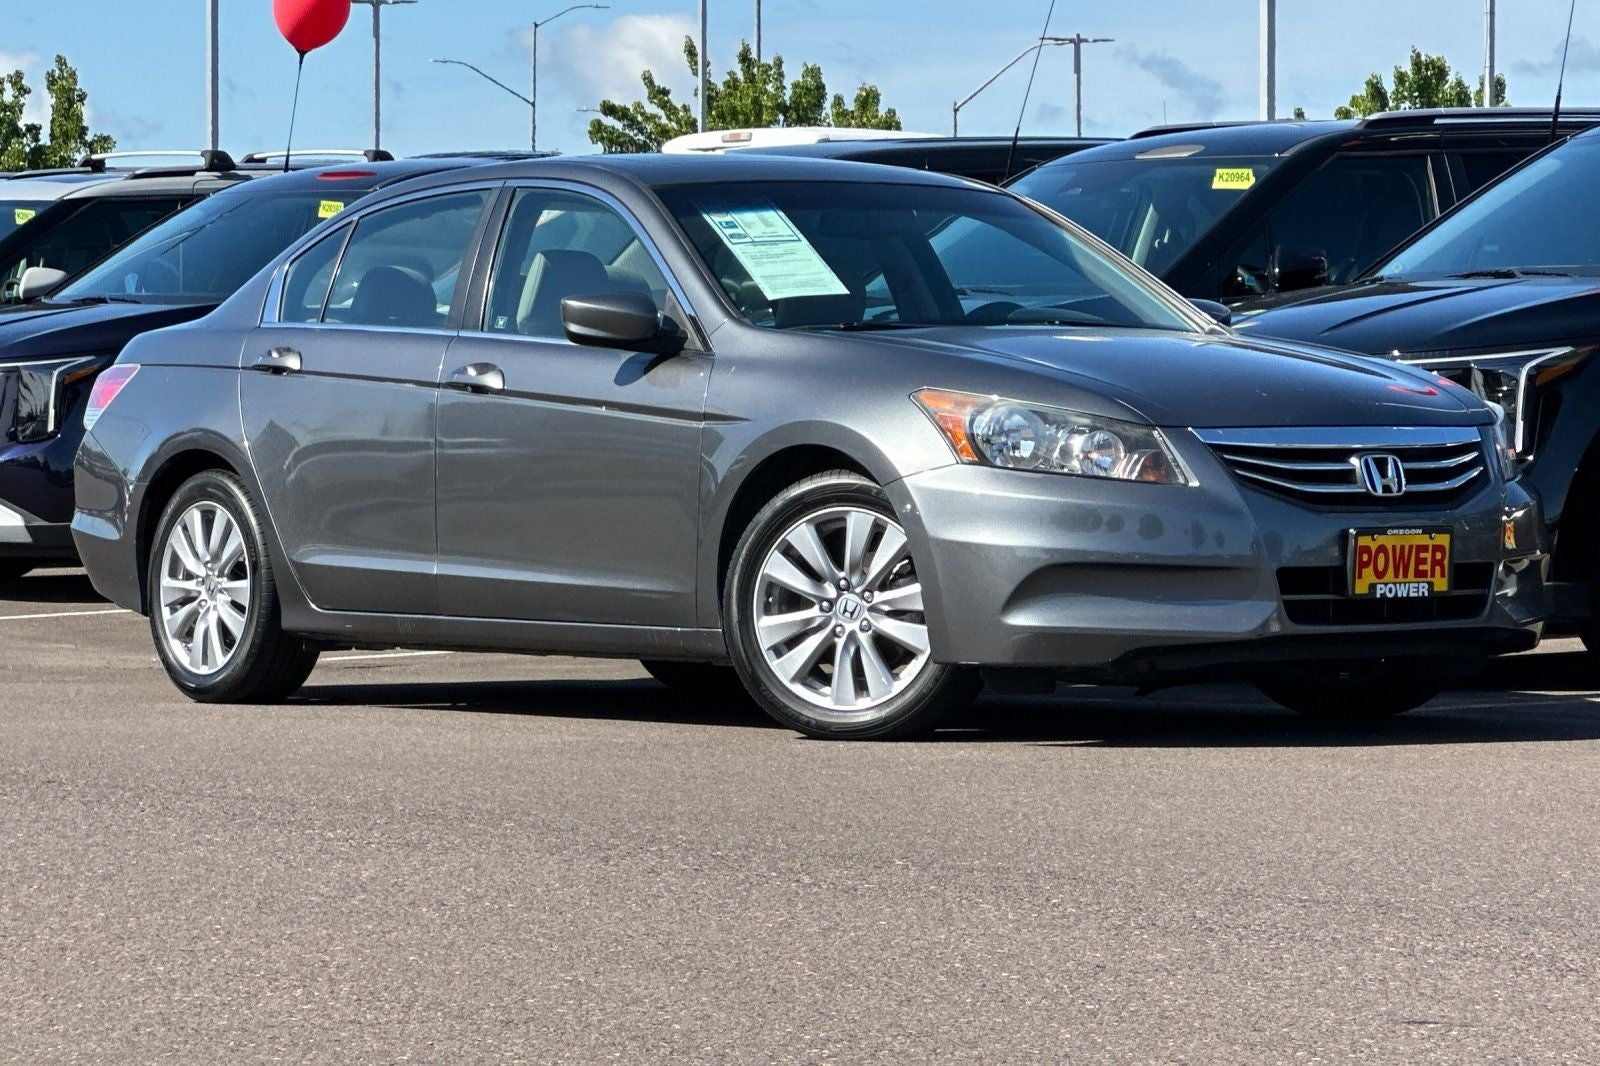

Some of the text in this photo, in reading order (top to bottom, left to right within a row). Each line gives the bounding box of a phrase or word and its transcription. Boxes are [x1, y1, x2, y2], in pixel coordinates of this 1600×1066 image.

[1218, 172, 1250, 182] K20964
[1357, 543, 1447, 580] POWER
[1376, 582, 1429, 598] POWER
